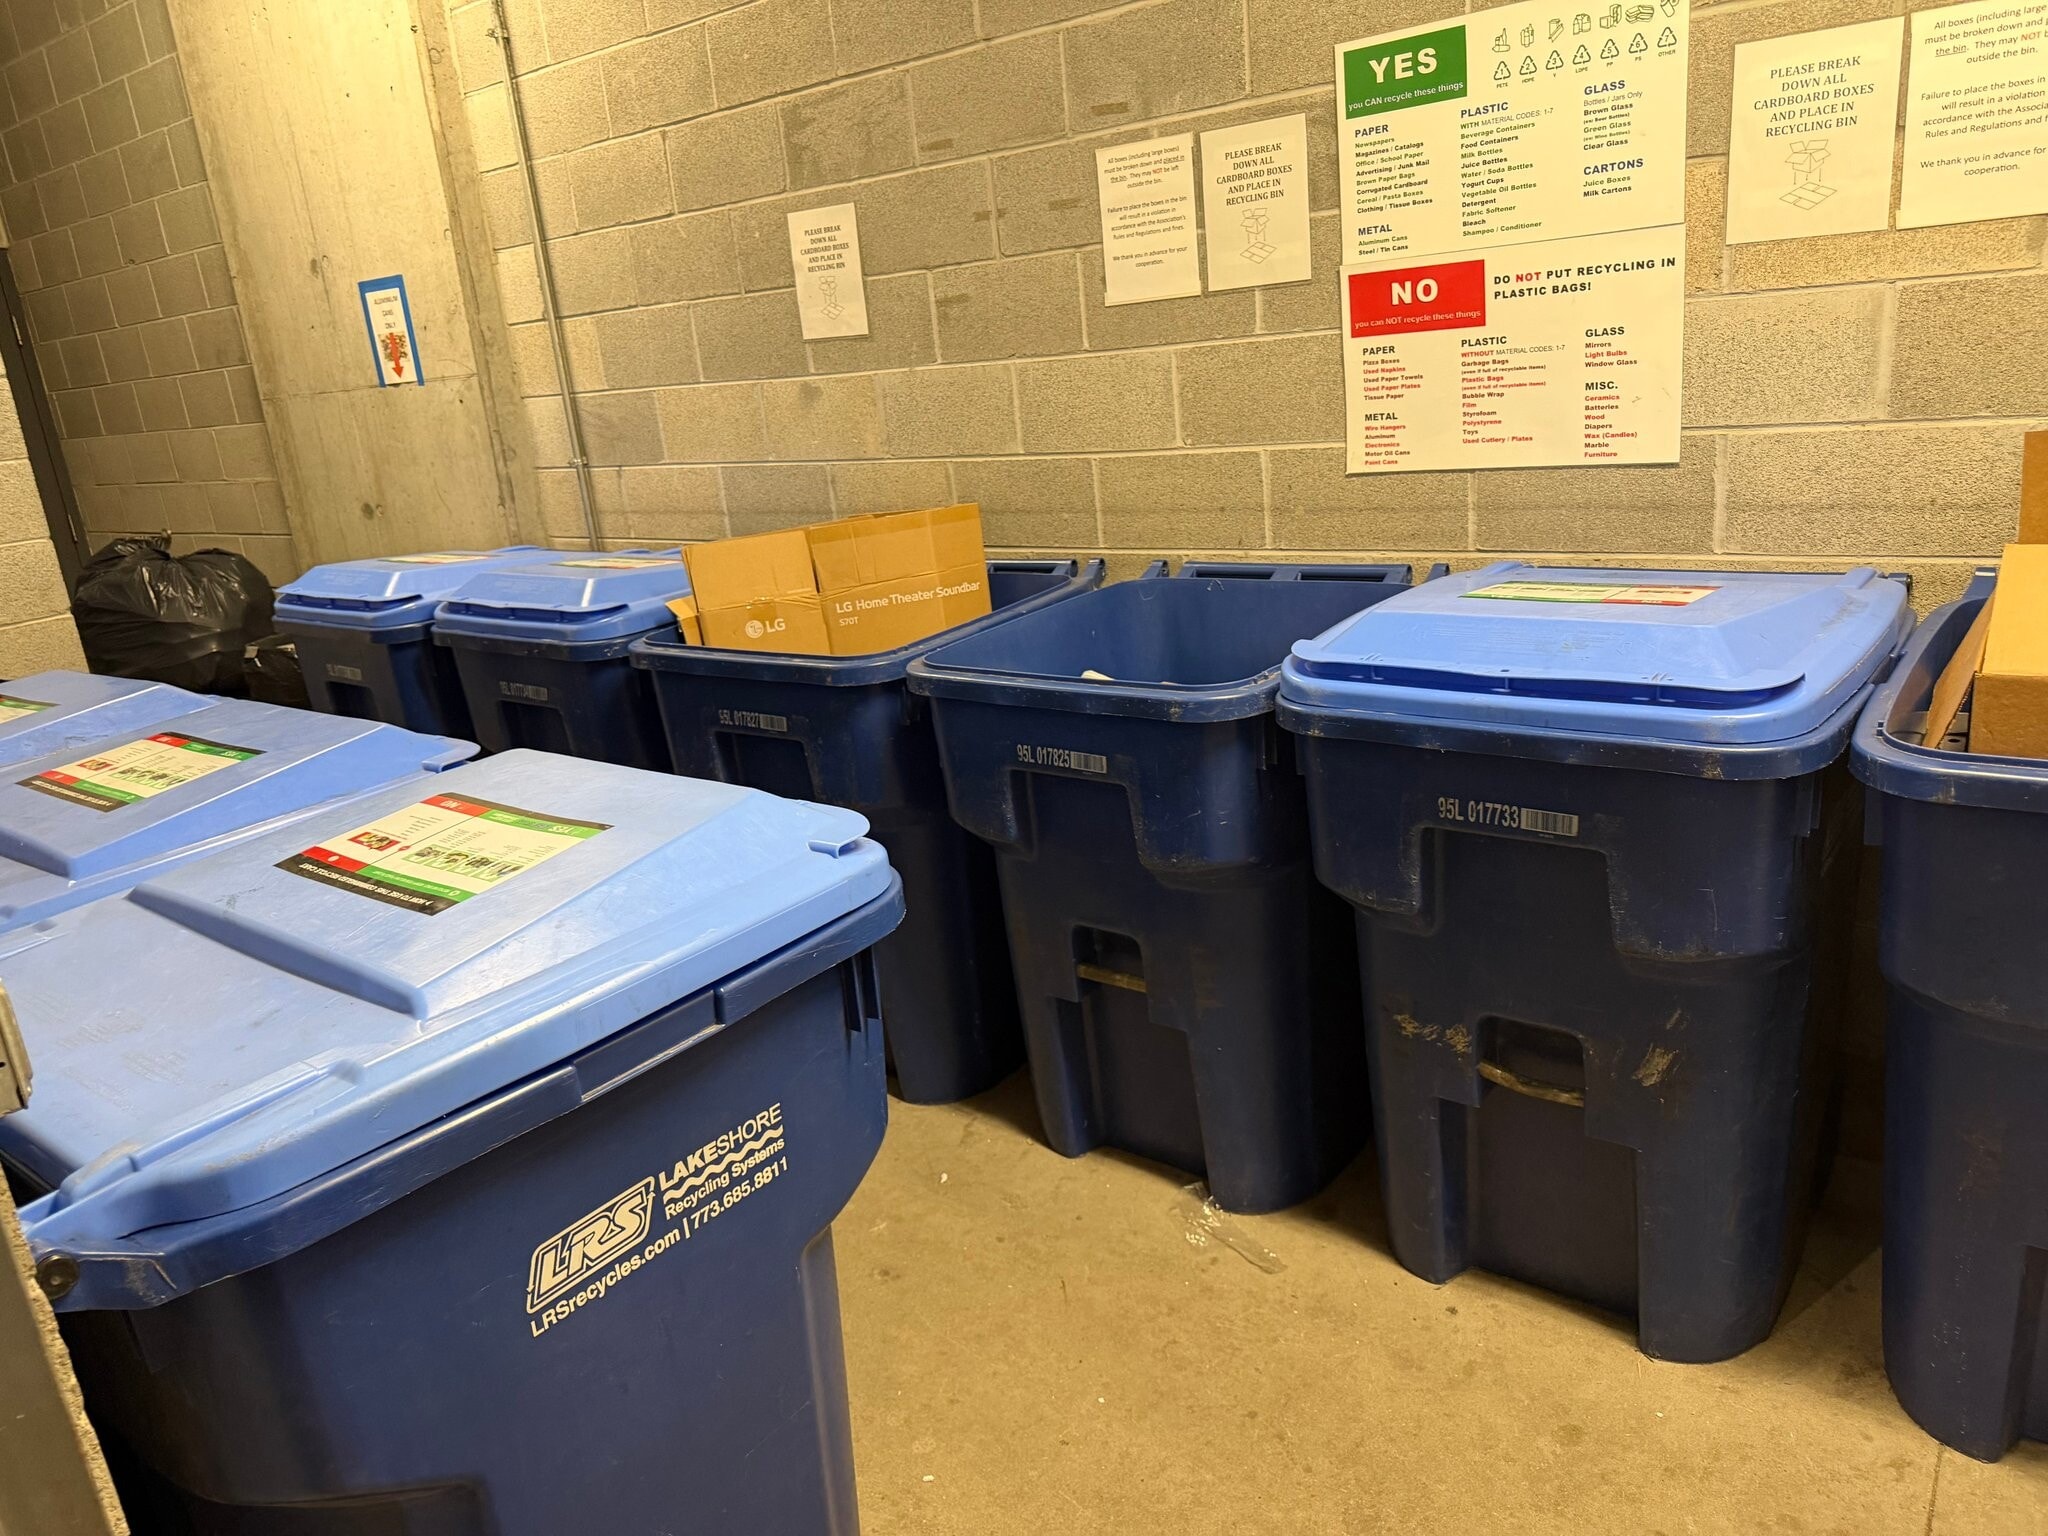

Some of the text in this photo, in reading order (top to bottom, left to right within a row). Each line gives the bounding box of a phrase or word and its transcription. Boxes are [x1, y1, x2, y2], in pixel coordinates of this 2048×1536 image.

[1935, 5, 2047, 30] All boxes (including large
[1925, 17, 2043, 44] must be broken down and
[1935, 31, 2042, 56] the bin. They may NOT
[1967, 46, 2038, 63] outside the bin.
[1369, 47, 1437, 83] YES
[1770, 56, 1861, 79] PLEASE BREAK
[1584, 80, 1625, 95] GLASS
[1782, 73, 1847, 91] DOWN ALL
[1921, 91, 1950, 100] Failure
[1964, 85, 1988, 95] place
[1991, 82, 2006, 90] the
[2008, 78, 2034, 88] boxes
[1348, 82, 1463, 111] you CAN recycle these things
[1754, 83, 1874, 110] CARDBOARD BOXES
[1942, 102, 1956, 111] will
[1959, 98, 1984, 108] result
[2006, 90, 2045, 101] violation
[1461, 102, 1508, 118] PLASTIC
[1770, 101, 1854, 122] AND PLACE IN
[1923, 114, 1972, 126] accordance
[1976, 109, 1995, 118] with
[1998, 108, 2012, 116] the
[1461, 121, 1479, 129] WITH
[1481, 115, 1514, 126] MATERIAL
[1516, 110, 1541, 120] CODES:
[1766, 116, 1858, 137] RECYCLING BIN
[1926, 116, 2042, 138] Rules and Regulations and
[1355, 124, 1389, 138] PAPER
[1461, 135, 1518, 149] Food Containers
[1225, 143, 1282, 160] PLEASE BREAK
[1937, 157, 1961, 166] thank
[1964, 156, 1980, 164] you
[1993, 149, 2031, 159] advance
[2034, 146, 2046, 154] for
[1233, 156, 1274, 170] DOWN ALL
[1584, 158, 1643, 175] CARTONS
[1964, 163, 2020, 176] cooperation.
[1217, 164, 1292, 184] CARDBOARD BOXES
[1228, 178, 1280, 194] AND PLACE IN
[1357, 179, 1428, 195] Corrugated Cardboard
[1601, 185, 1632, 194] Cartons
[1226, 189, 1284, 206] RECYCLING BIN
[1462, 198, 1496, 208] Detergent
[804, 225, 841, 236] PLEASE BREAK
[1358, 224, 1392, 236] METAL
[800, 246, 831, 255] CARDBOARD
[808, 263, 835, 272] RECYCLING
[1494, 257, 1676, 284] DO NOT PUT RECYCLING IN
[1391, 278, 1438, 305] NO
[1494, 282, 1592, 299] PLASTIC BAGS!
[1385, 317, 1402, 325] NOT
[1404, 315, 1431, 325] recycle
[1433, 312, 1454, 320] these
[1456, 310, 1481, 319] things
[1585, 326, 1625, 337] GLASS
[1461, 336, 1507, 347] PLASTIC
[1363, 346, 1395, 356] PAPER
[1461, 350, 1494, 358] WITHOUT
[1585, 381, 1618, 390] MISC.
[1365, 412, 1397, 421] METAL
[836, 582, 980, 613] LG Home Theater Soundbar
[766, 618, 785, 633] LG
[840, 616, 859, 626] S70T
[1017, 744, 1070, 768] 95L 017825
[1438, 797, 1519, 827] 95L 017733
[659, 1103, 782, 1191] LAKESHORE
[665, 1138, 785, 1220] Recycling Systems
[531, 1156, 788, 1337] LRSrecycles.com 773.685.8811
[533, 1185, 649, 1306] LRS
